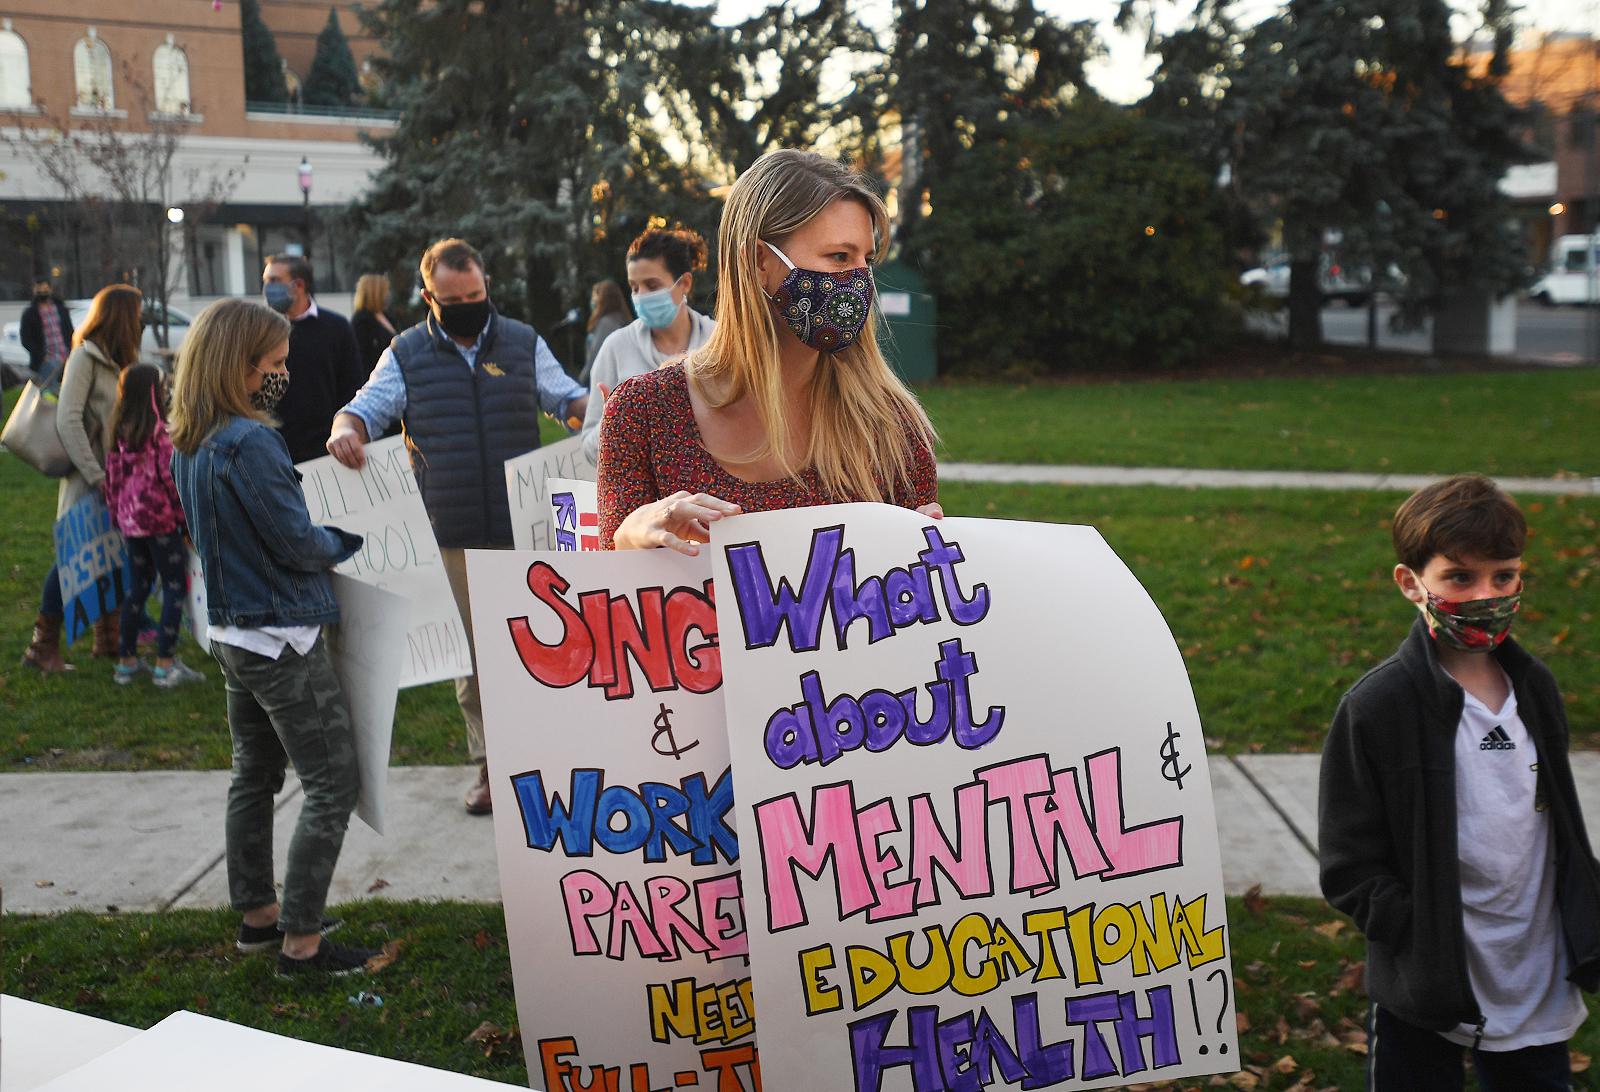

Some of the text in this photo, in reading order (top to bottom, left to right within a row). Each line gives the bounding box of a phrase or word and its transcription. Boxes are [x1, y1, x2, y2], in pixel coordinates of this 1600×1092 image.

[507, 560, 723, 701] SING
[724, 524, 991, 653] What
[763, 638, 1005, 770] about
[1480, 741, 1516, 750] adidas
[510, 764, 741, 865] WORK
[753, 747, 1183, 933] MENTAL
[560, 869, 750, 966] PARE
[798, 892, 1226, 1016] EDUCATIONAL
